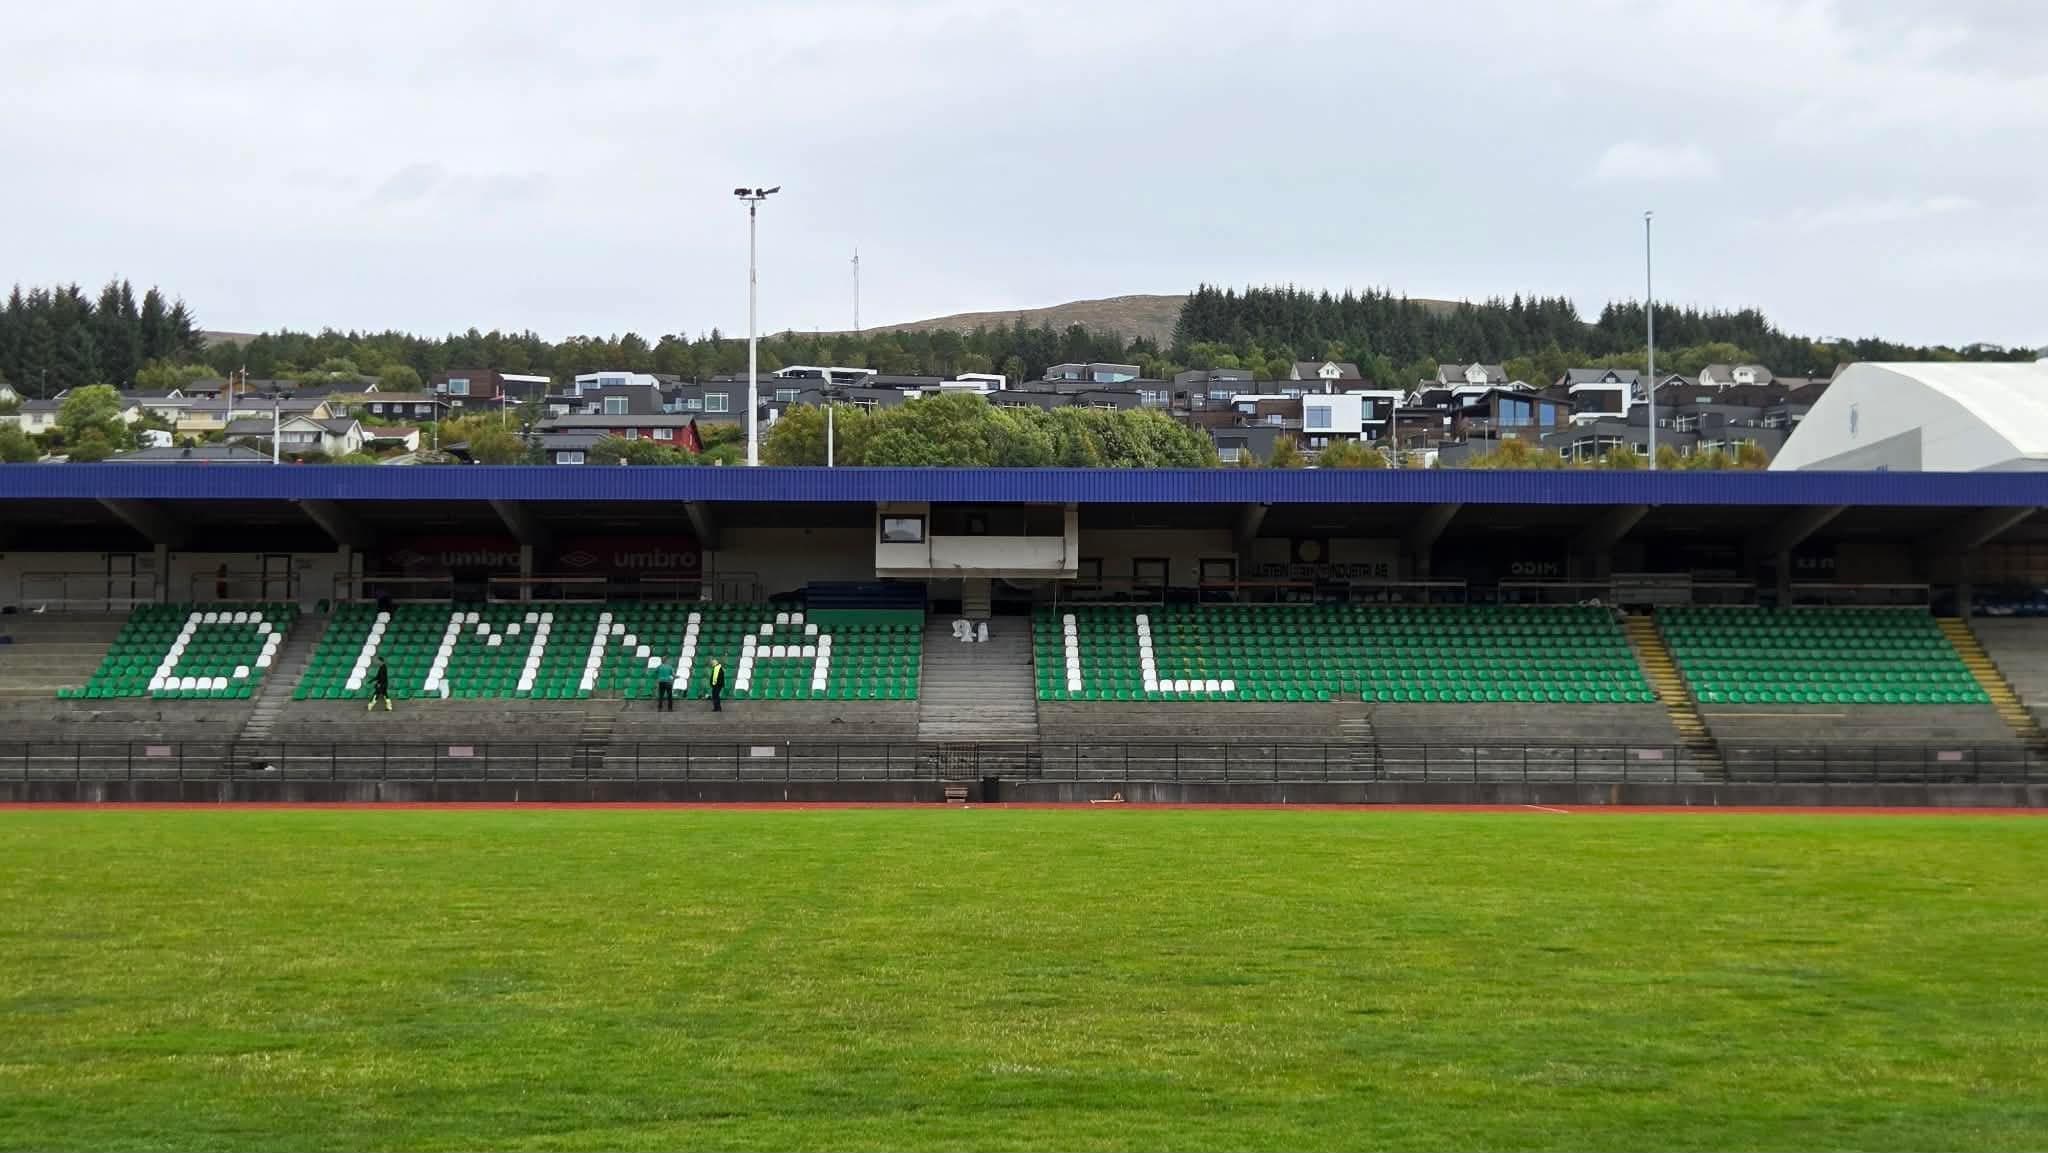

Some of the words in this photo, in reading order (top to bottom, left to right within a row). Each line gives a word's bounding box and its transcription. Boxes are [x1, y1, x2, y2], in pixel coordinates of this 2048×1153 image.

[440, 547, 520, 568] umbro
[612, 546, 697, 568] umbro
[1511, 560, 1560, 576] ODIM
[147, 611, 833, 691] DIMNA
[1062, 613, 1236, 692] IL
